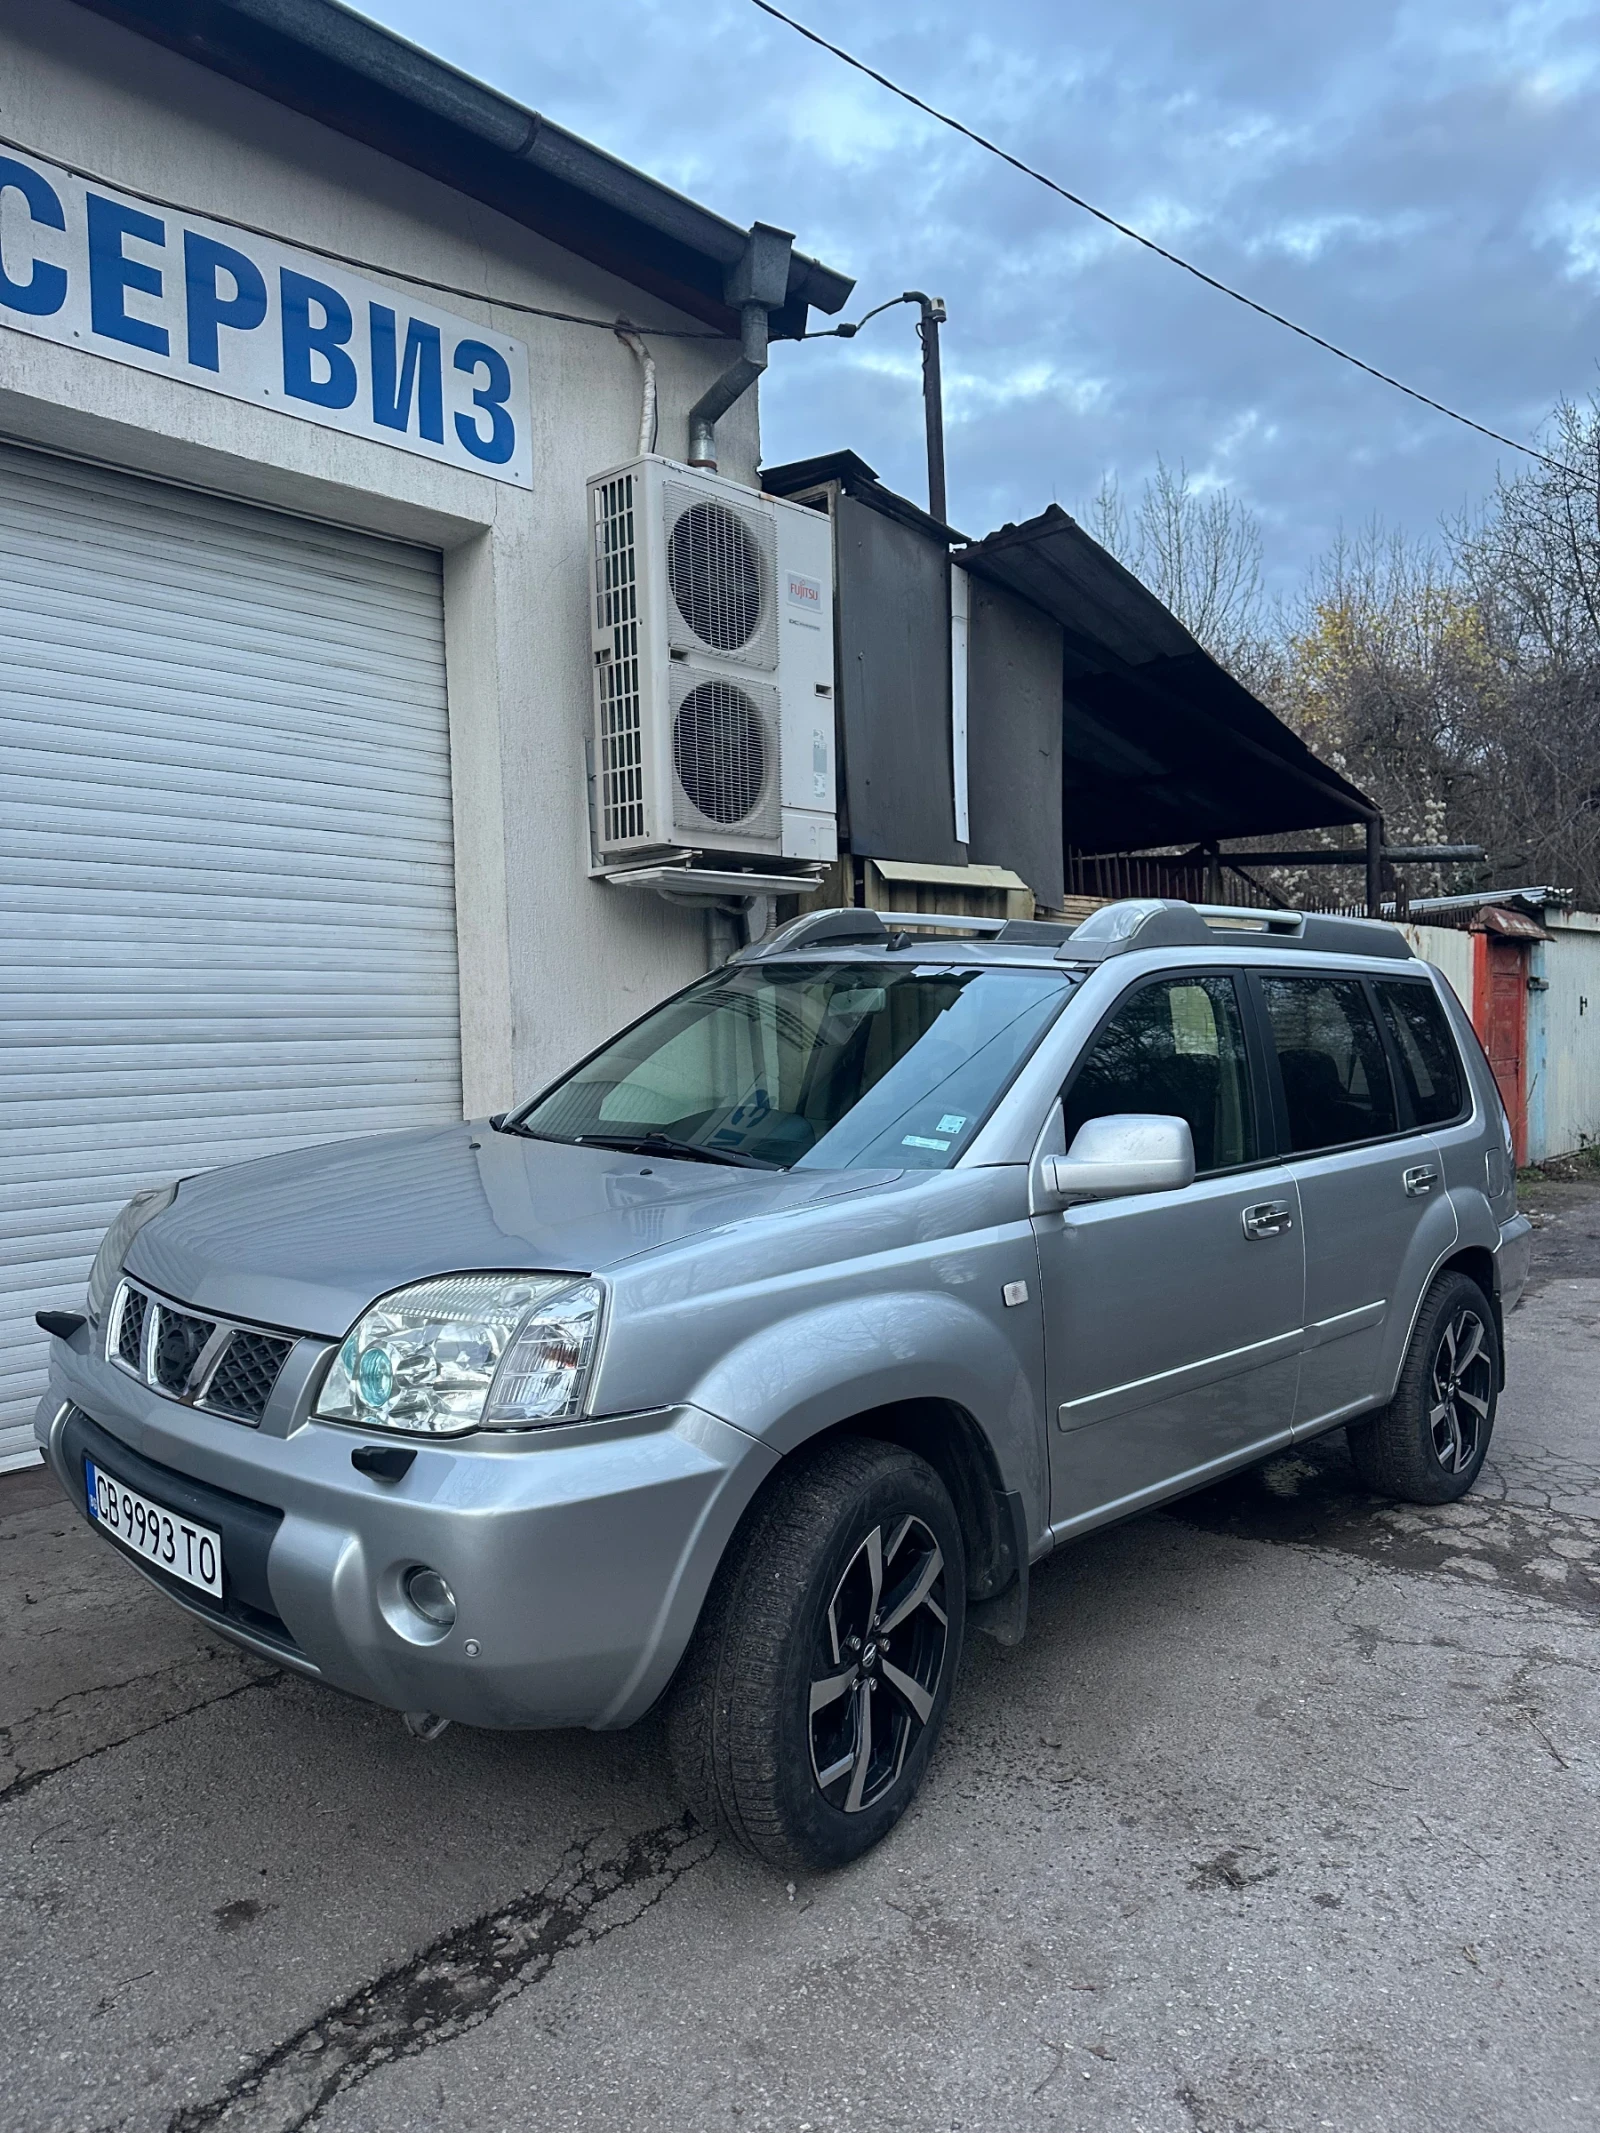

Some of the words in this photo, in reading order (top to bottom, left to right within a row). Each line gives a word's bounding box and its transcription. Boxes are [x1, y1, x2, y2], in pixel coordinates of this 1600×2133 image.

[0, 155, 515, 464] СЕРВИЗ
[790, 580, 818, 601] FUJITSU
[97, 1475, 120, 1528] CB
[122, 1494, 176, 1563] 9993
